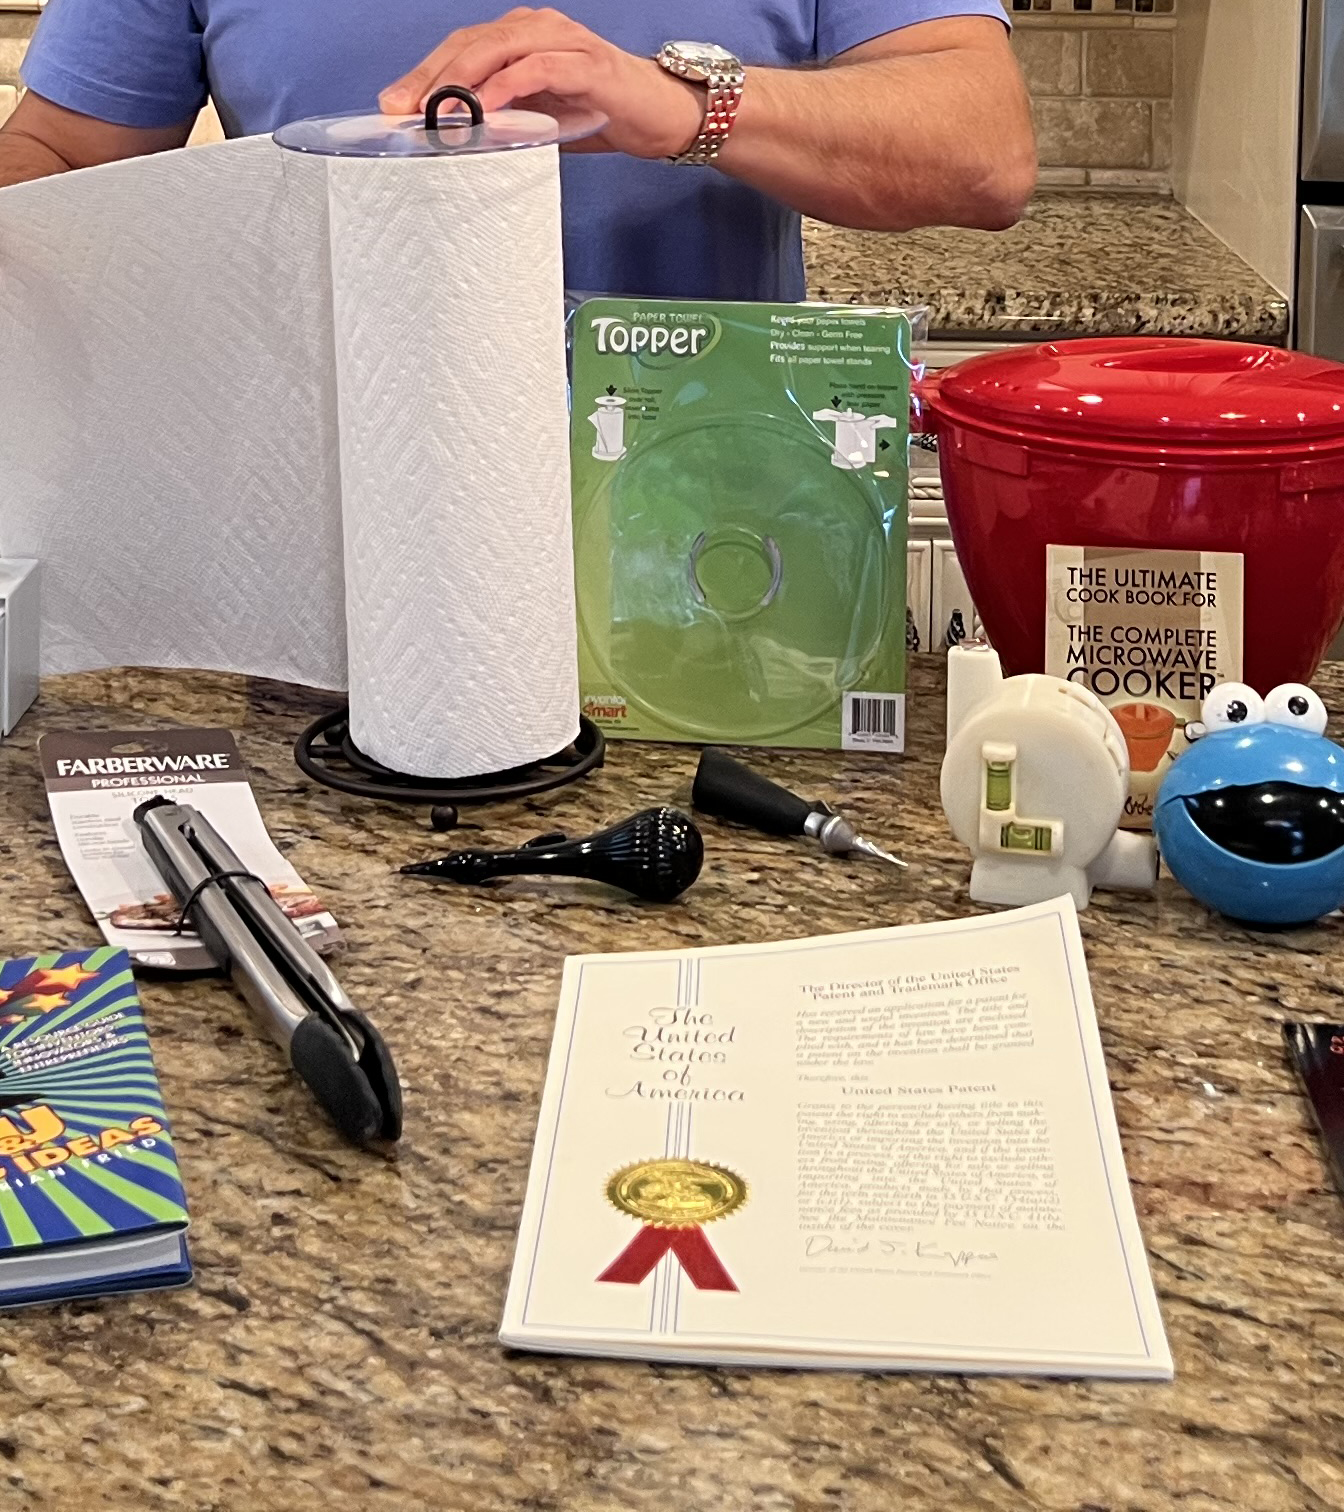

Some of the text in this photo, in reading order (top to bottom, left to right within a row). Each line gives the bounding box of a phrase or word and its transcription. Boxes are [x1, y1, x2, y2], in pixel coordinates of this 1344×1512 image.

[633, 312, 704, 324] PAPER TOWEL
[590, 317, 707, 355] Topper
[770, 328, 785, 339] Dry
[791, 329, 815, 338] Clean
[770, 340, 806, 351] Provides
[808, 344, 838, 354] support
[840, 344, 862, 352] when
[770, 354, 785, 363] Fits
[1066, 567, 1217, 591] THE ULTIMATE
[1066, 588, 1217, 608] COOK BOOK FOR
[1066, 625, 1217, 647] THE COMPLETE
[1066, 645, 1217, 670] MICROWAVE
[57, 753, 229, 776] FARBERWARE
[92, 774, 206, 788] PROFESSIONAL
[799, 965, 1021, 994] The Director of the United States
[813, 974, 1008, 1001] Patent and Trademark Office
[648, 1006, 713, 1026] The
[622, 1025, 736, 1044] United
[629, 1043, 726, 1063] States
[662, 1064, 691, 1087] of
[605, 1081, 744, 1101] America
[841, 1083, 996, 1096] United States Patent
[12, 1116, 163, 1175] IDEAS
[82, 1138, 157, 1168] FRIED
